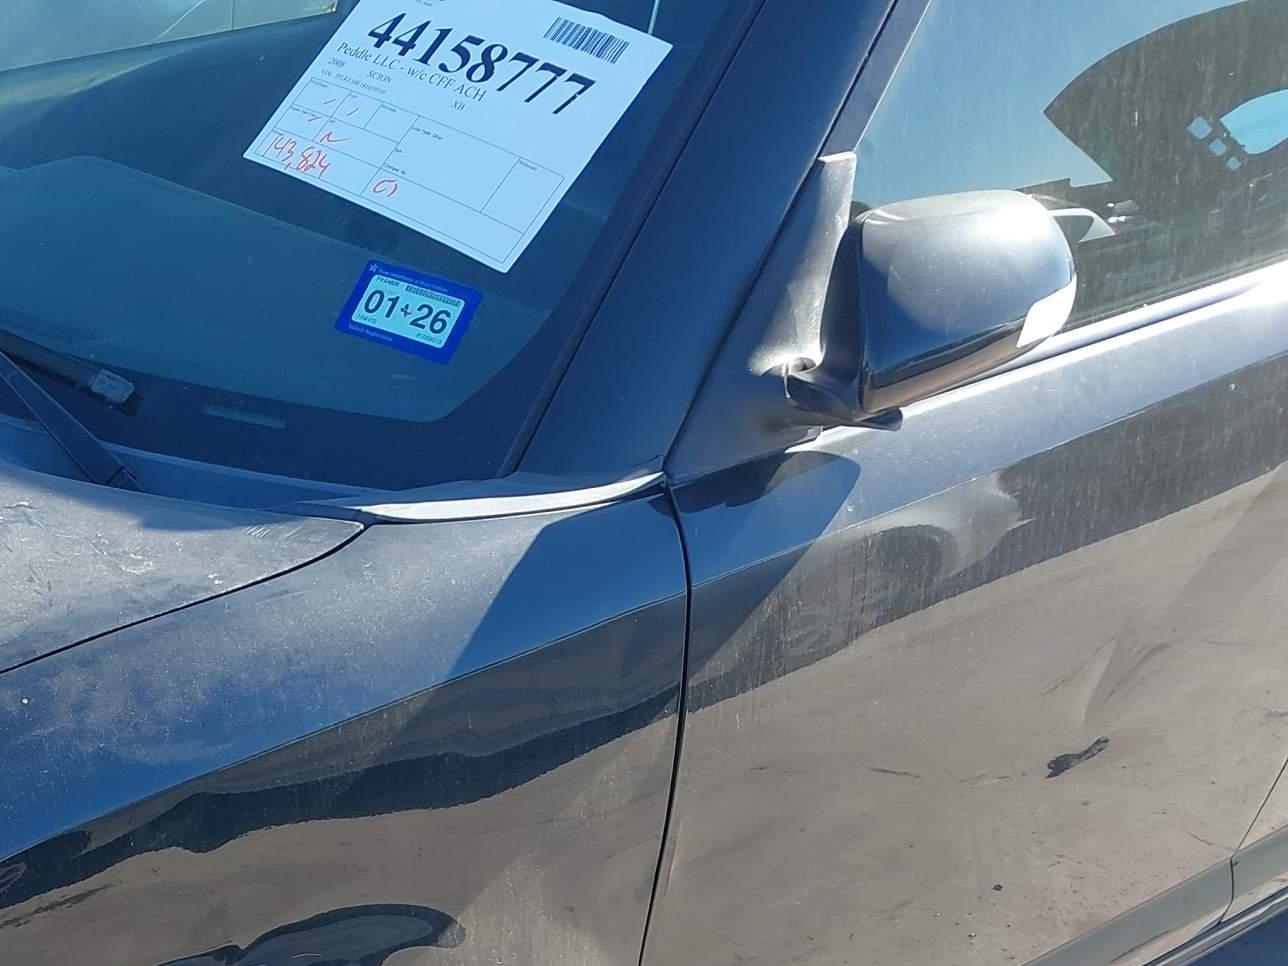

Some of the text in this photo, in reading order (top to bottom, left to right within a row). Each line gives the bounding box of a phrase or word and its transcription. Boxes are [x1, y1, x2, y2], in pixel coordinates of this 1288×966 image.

[336, 41, 373, 62] Peddle
[372, 55, 400, 71] LLC
[407, 66, 427, 81] w/c
[428, 73, 456, 90] CFF
[453, 83, 488, 102] ACH
[366, 69, 394, 84] SCION
[367, 12, 597, 115] 44158777
[363, 289, 452, 335] 01 26
